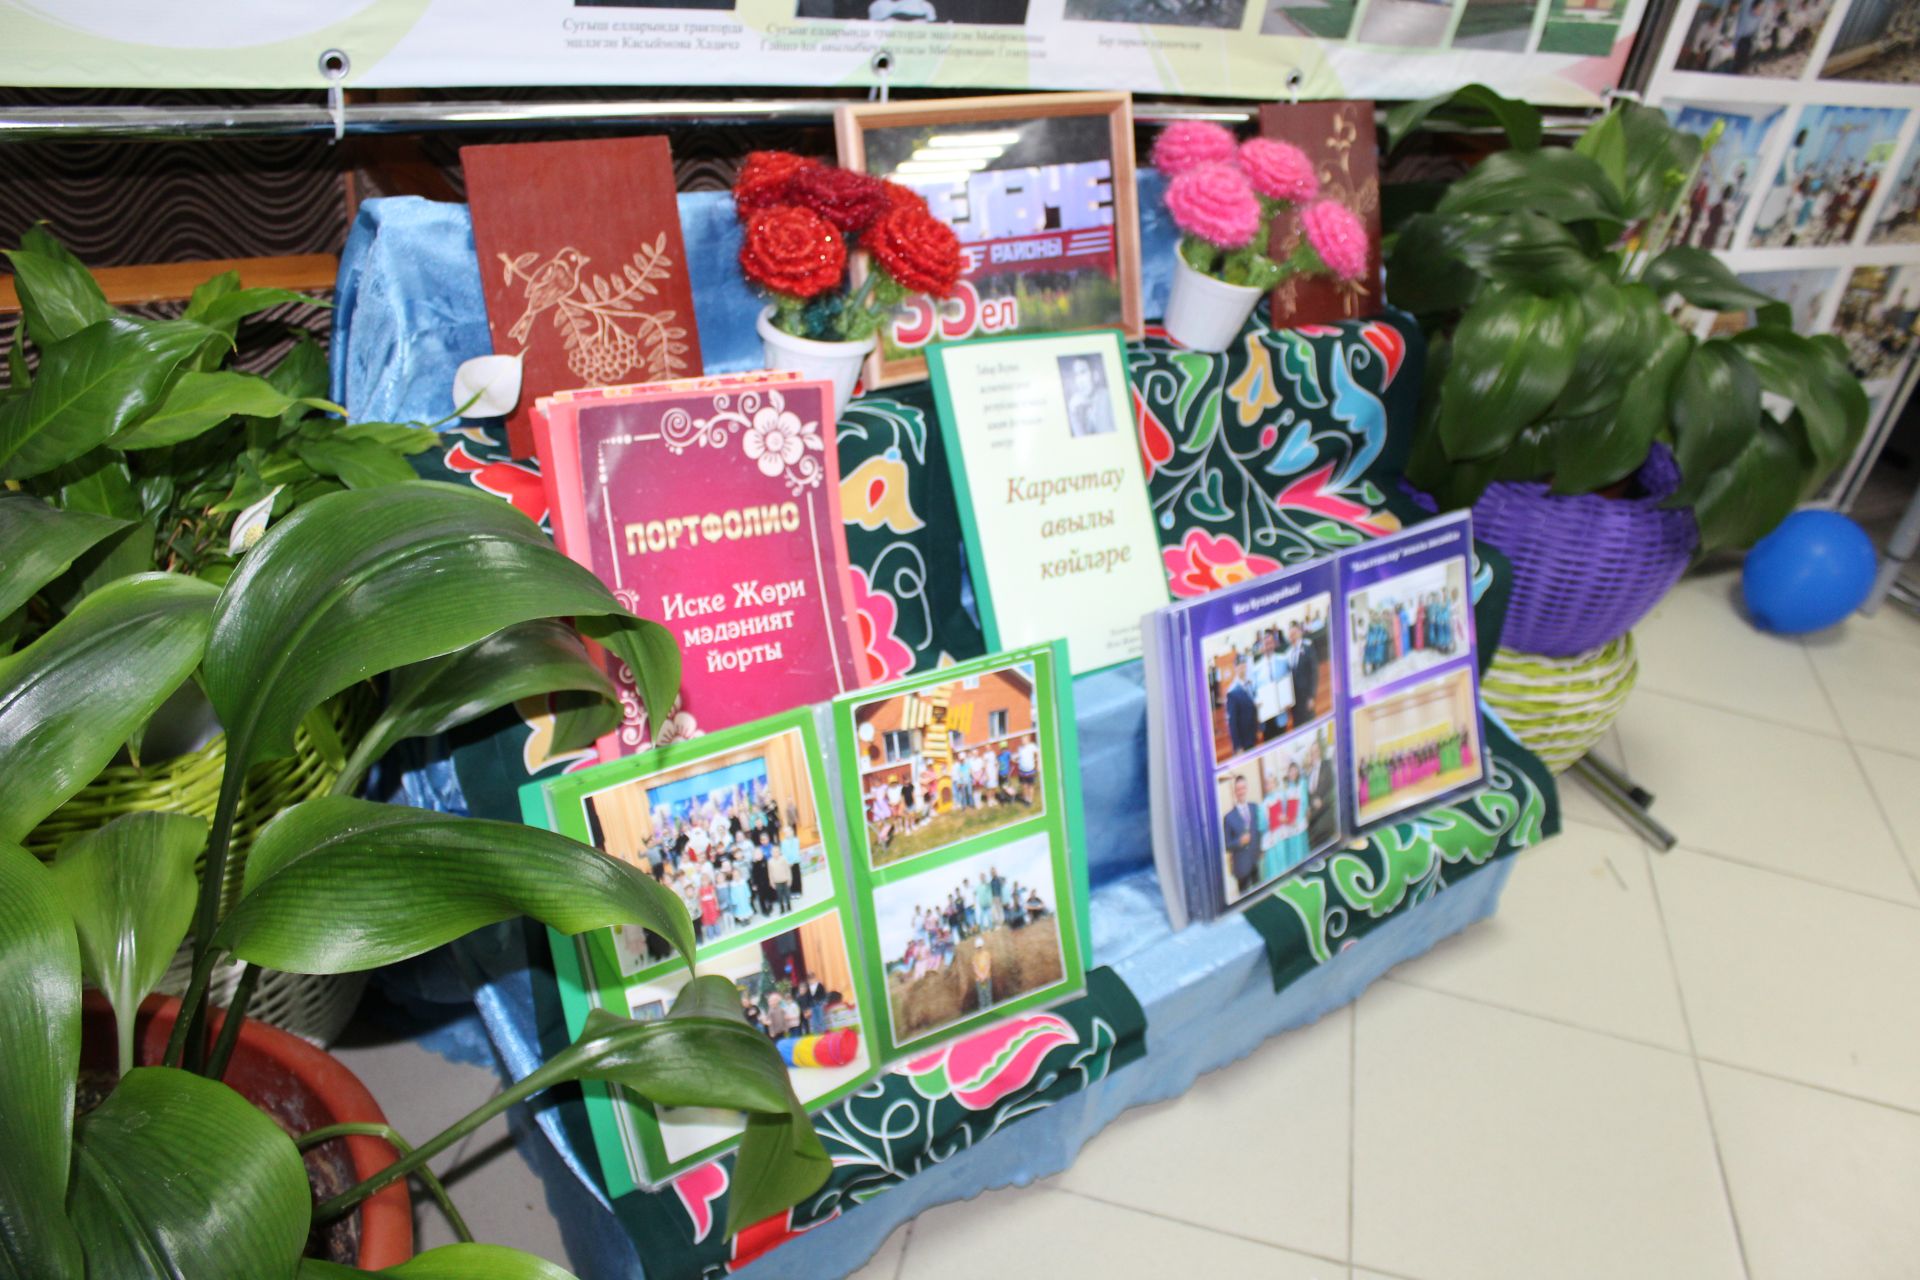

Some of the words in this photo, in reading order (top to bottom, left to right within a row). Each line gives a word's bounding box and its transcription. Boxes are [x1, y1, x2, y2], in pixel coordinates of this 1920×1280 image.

[990, 238, 1063, 264] РАЙОНЫ
[1006, 467, 1125, 505] Карачтау
[624, 501, 801, 556] ПОРТФОЛИО
[1041, 508, 1116, 539] авылы
[1041, 545, 1132, 580] көйләре
[661, 593, 727, 622] Иске
[682, 610, 795, 648] мәдәният
[706, 641, 784, 673] йорты
